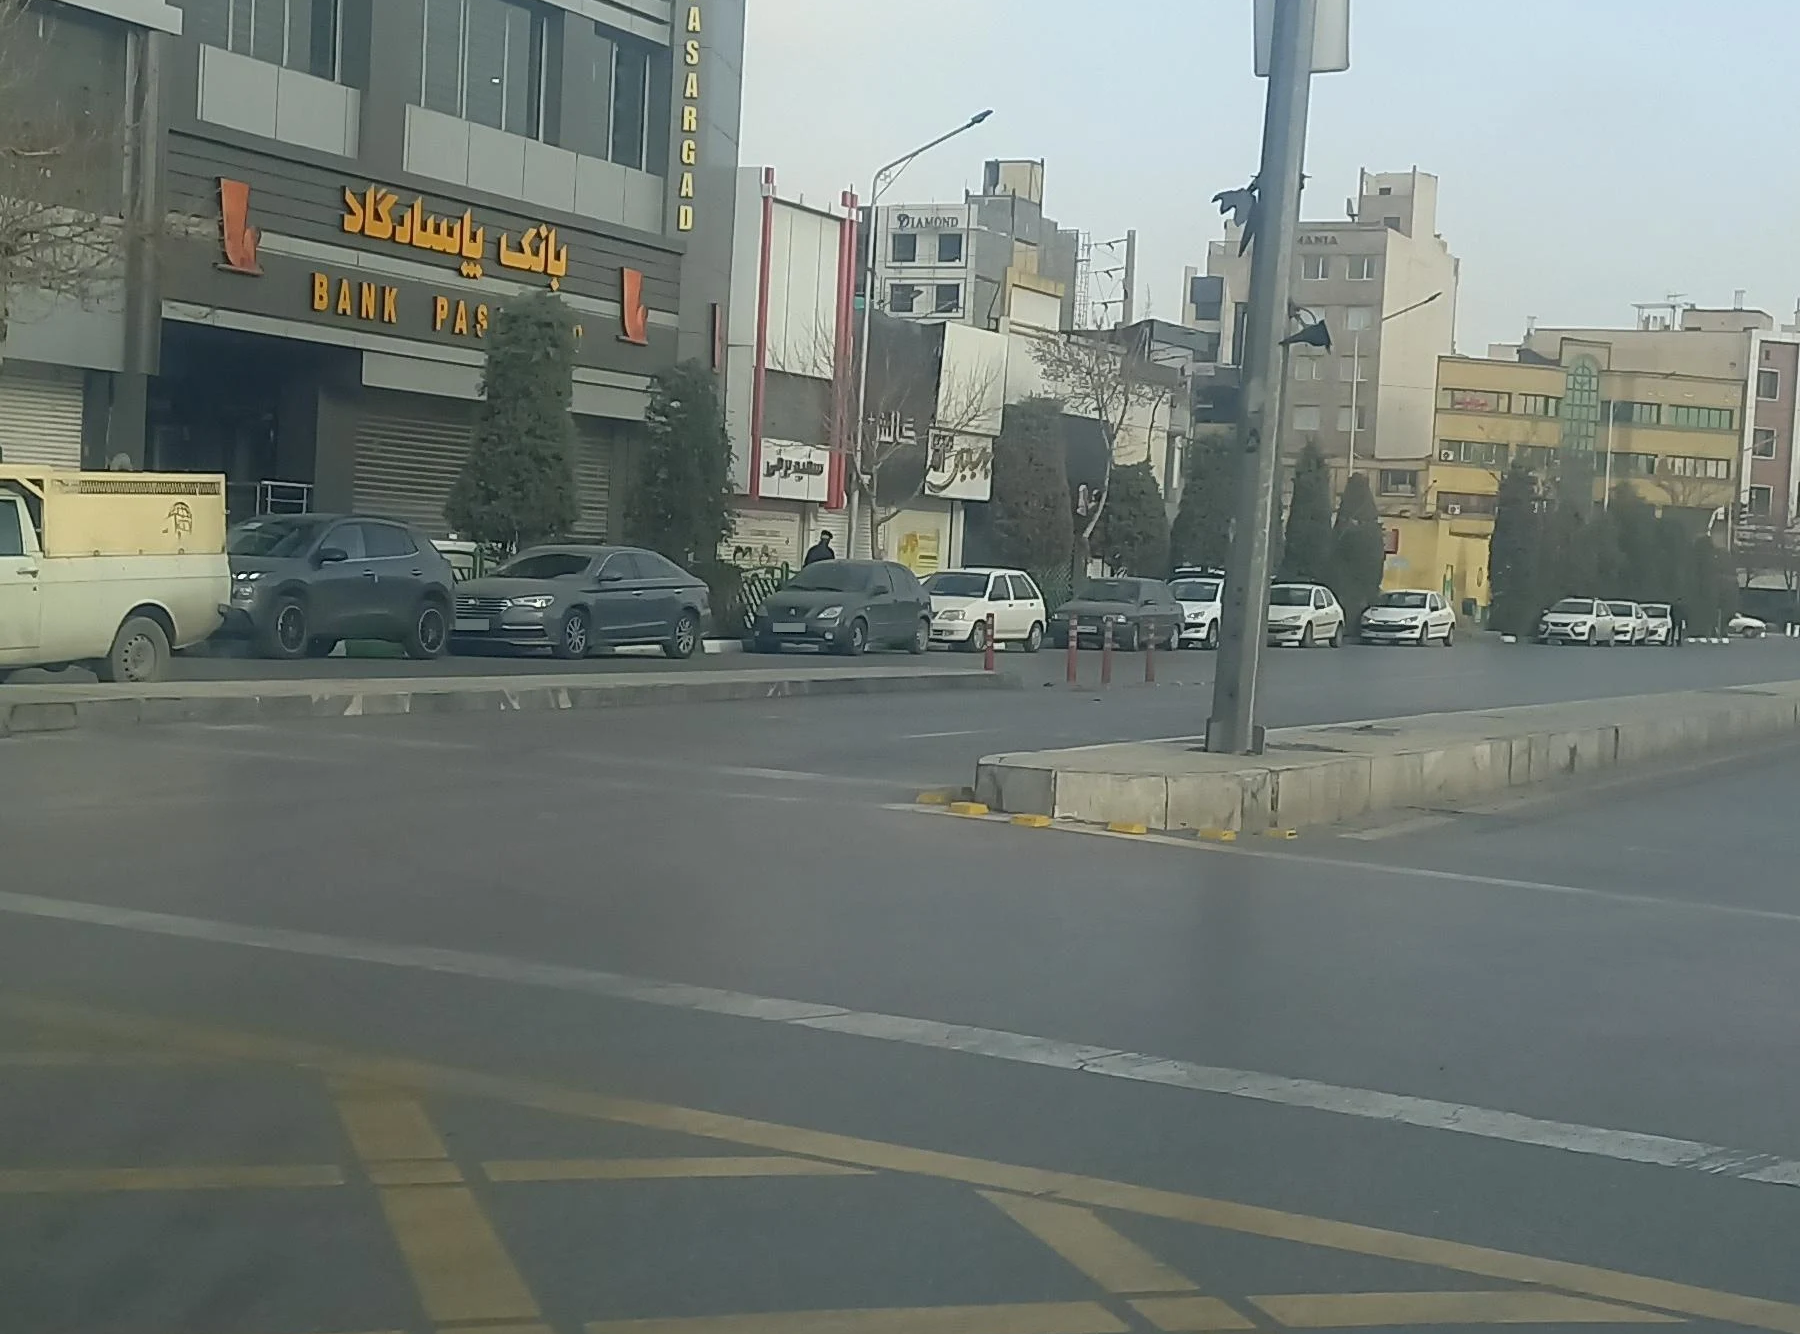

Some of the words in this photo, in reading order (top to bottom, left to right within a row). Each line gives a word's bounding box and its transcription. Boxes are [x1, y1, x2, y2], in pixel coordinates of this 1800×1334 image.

[343, 183, 484, 280] پاسارگاد
[500, 222, 568, 292] بانک
[311, 272, 398, 324] BANK
